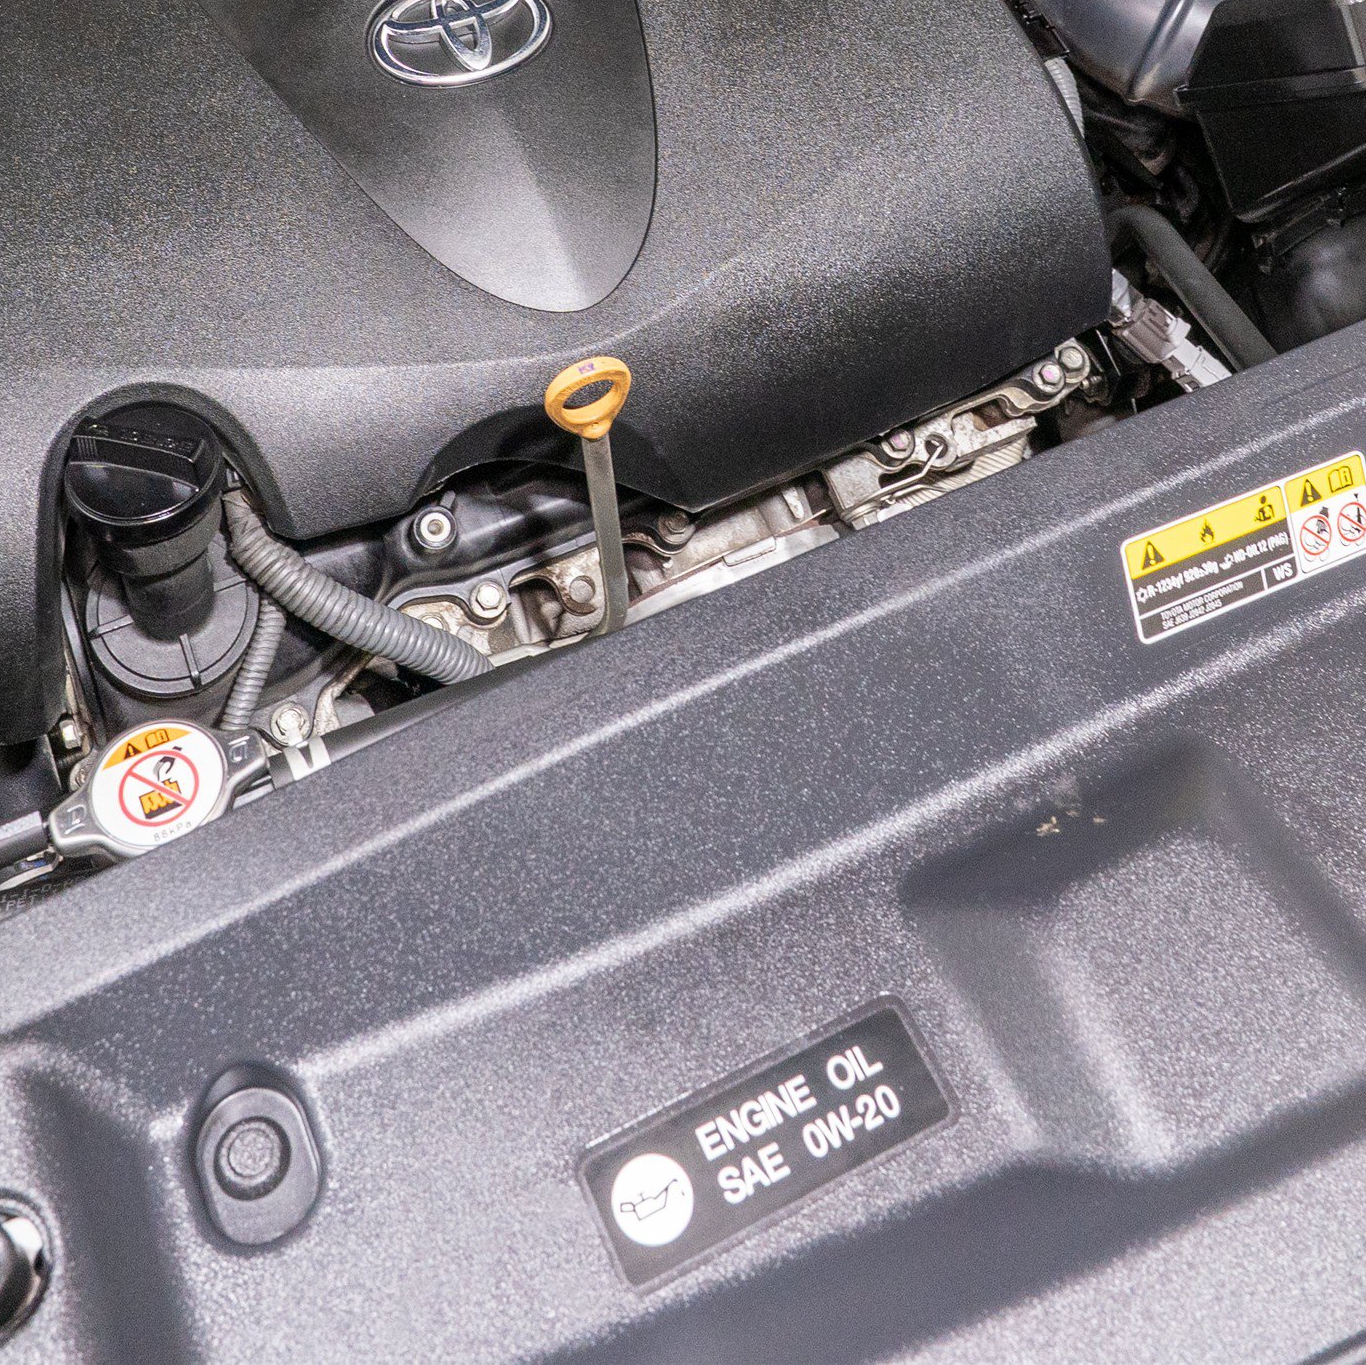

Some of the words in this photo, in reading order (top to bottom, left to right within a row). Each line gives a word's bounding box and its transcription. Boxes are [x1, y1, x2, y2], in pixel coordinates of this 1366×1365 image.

[1272, 562, 1293, 580] WS
[1160, 605, 1183, 621] TOYOTA
[1182, 597, 1204, 612] MOTOR
[1203, 581, 1244, 604] CORPORATION
[153, 821, 192, 842] 88kPa
[694, 1074, 817, 1162] ENGINE
[825, 1045, 884, 1091] OIL
[717, 1143, 791, 1205] SAE
[801, 1084, 902, 1159] 0W-20
